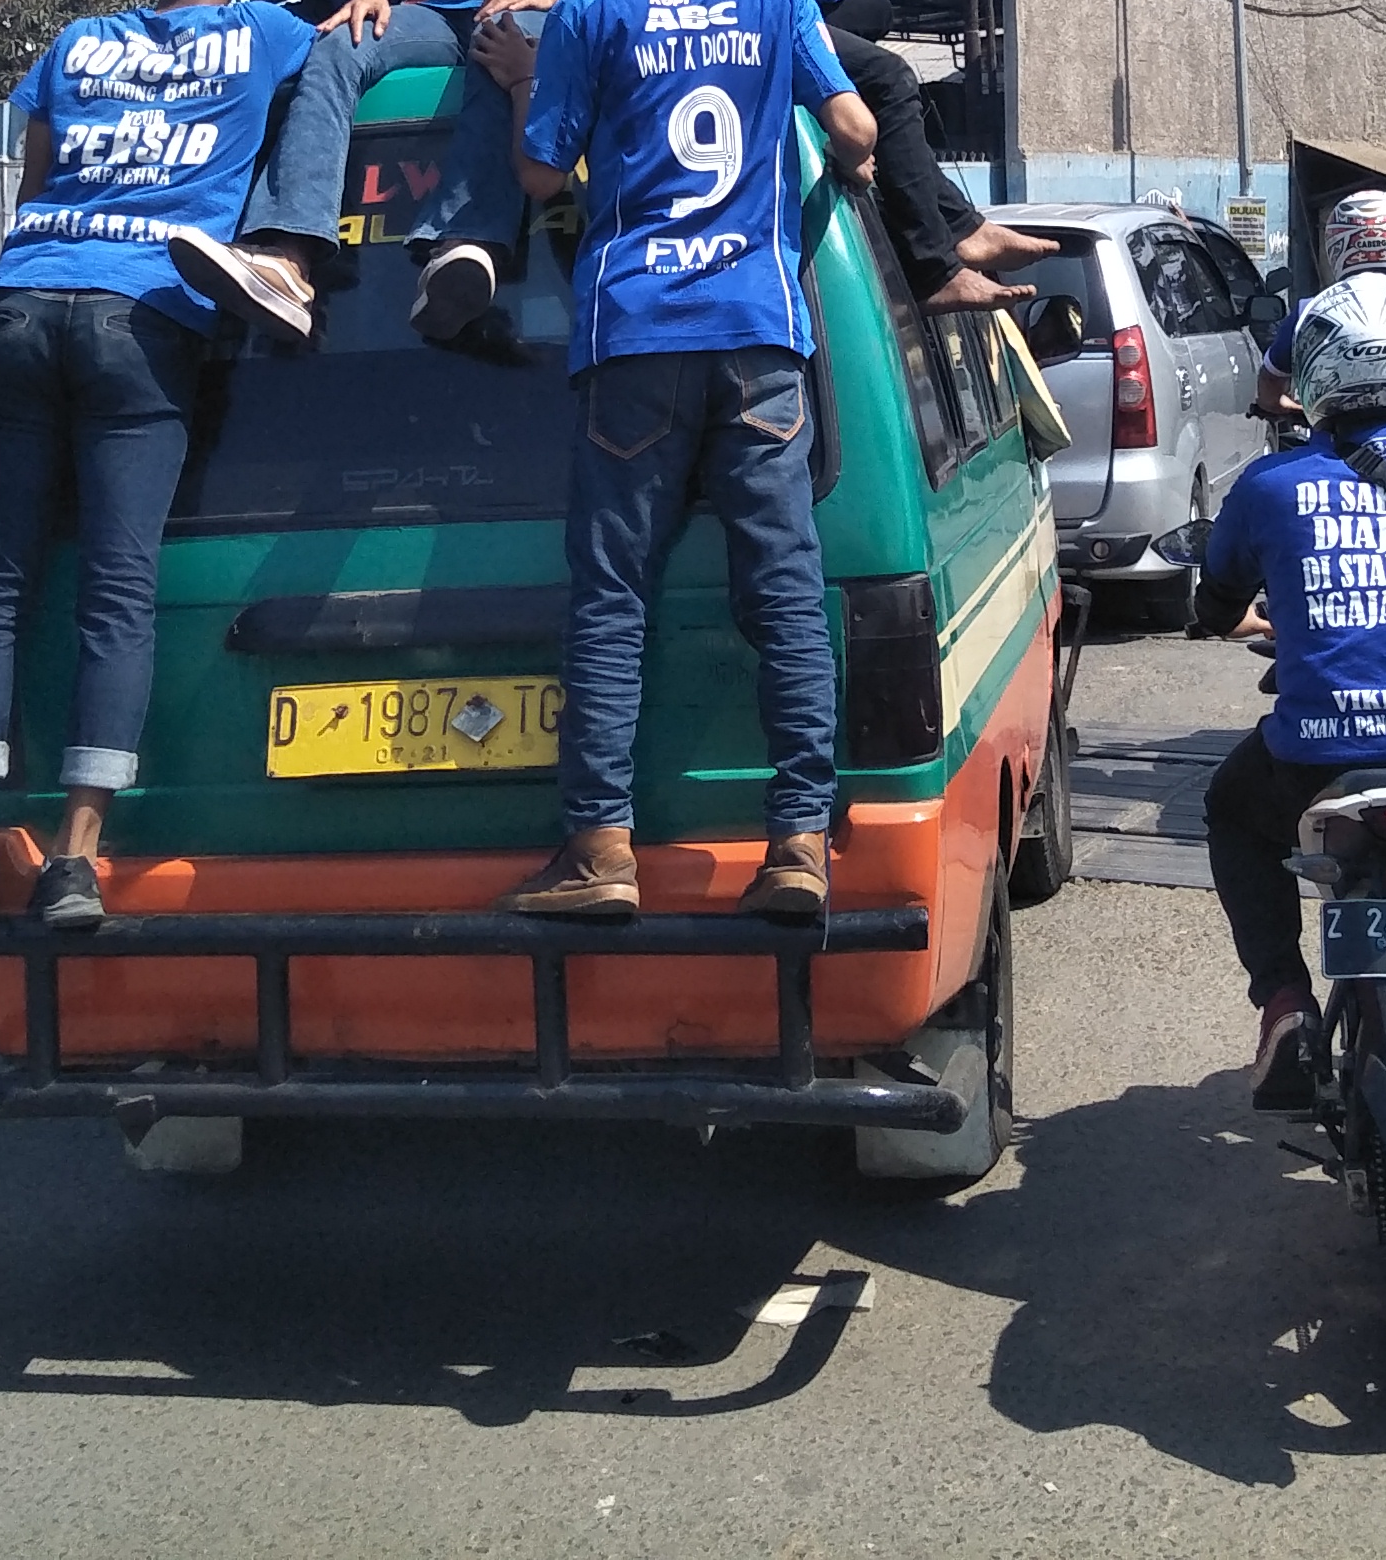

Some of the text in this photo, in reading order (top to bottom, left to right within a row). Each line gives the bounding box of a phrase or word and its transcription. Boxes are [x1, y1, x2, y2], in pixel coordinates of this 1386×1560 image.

[644, 1, 738, 32] ABC
[63, 26, 252, 83] BOBOTOH
[635, 30, 762, 79] IMAT X DIOTICK
[79, 77, 227, 102] BANDUNG BARAT
[58, 124, 219, 166] PERSIB
[668, 85, 743, 219] 9
[645, 233, 748, 266] FWD
[1296, 479, 1331, 516] DI
[1301, 555, 1333, 592] DI
[273, 684, 564, 747] D 1987 TG
[1299, 717, 1337, 740] SMAN
[1341, 717, 1350, 737] 1
[1327, 909, 1342, 938] Z
